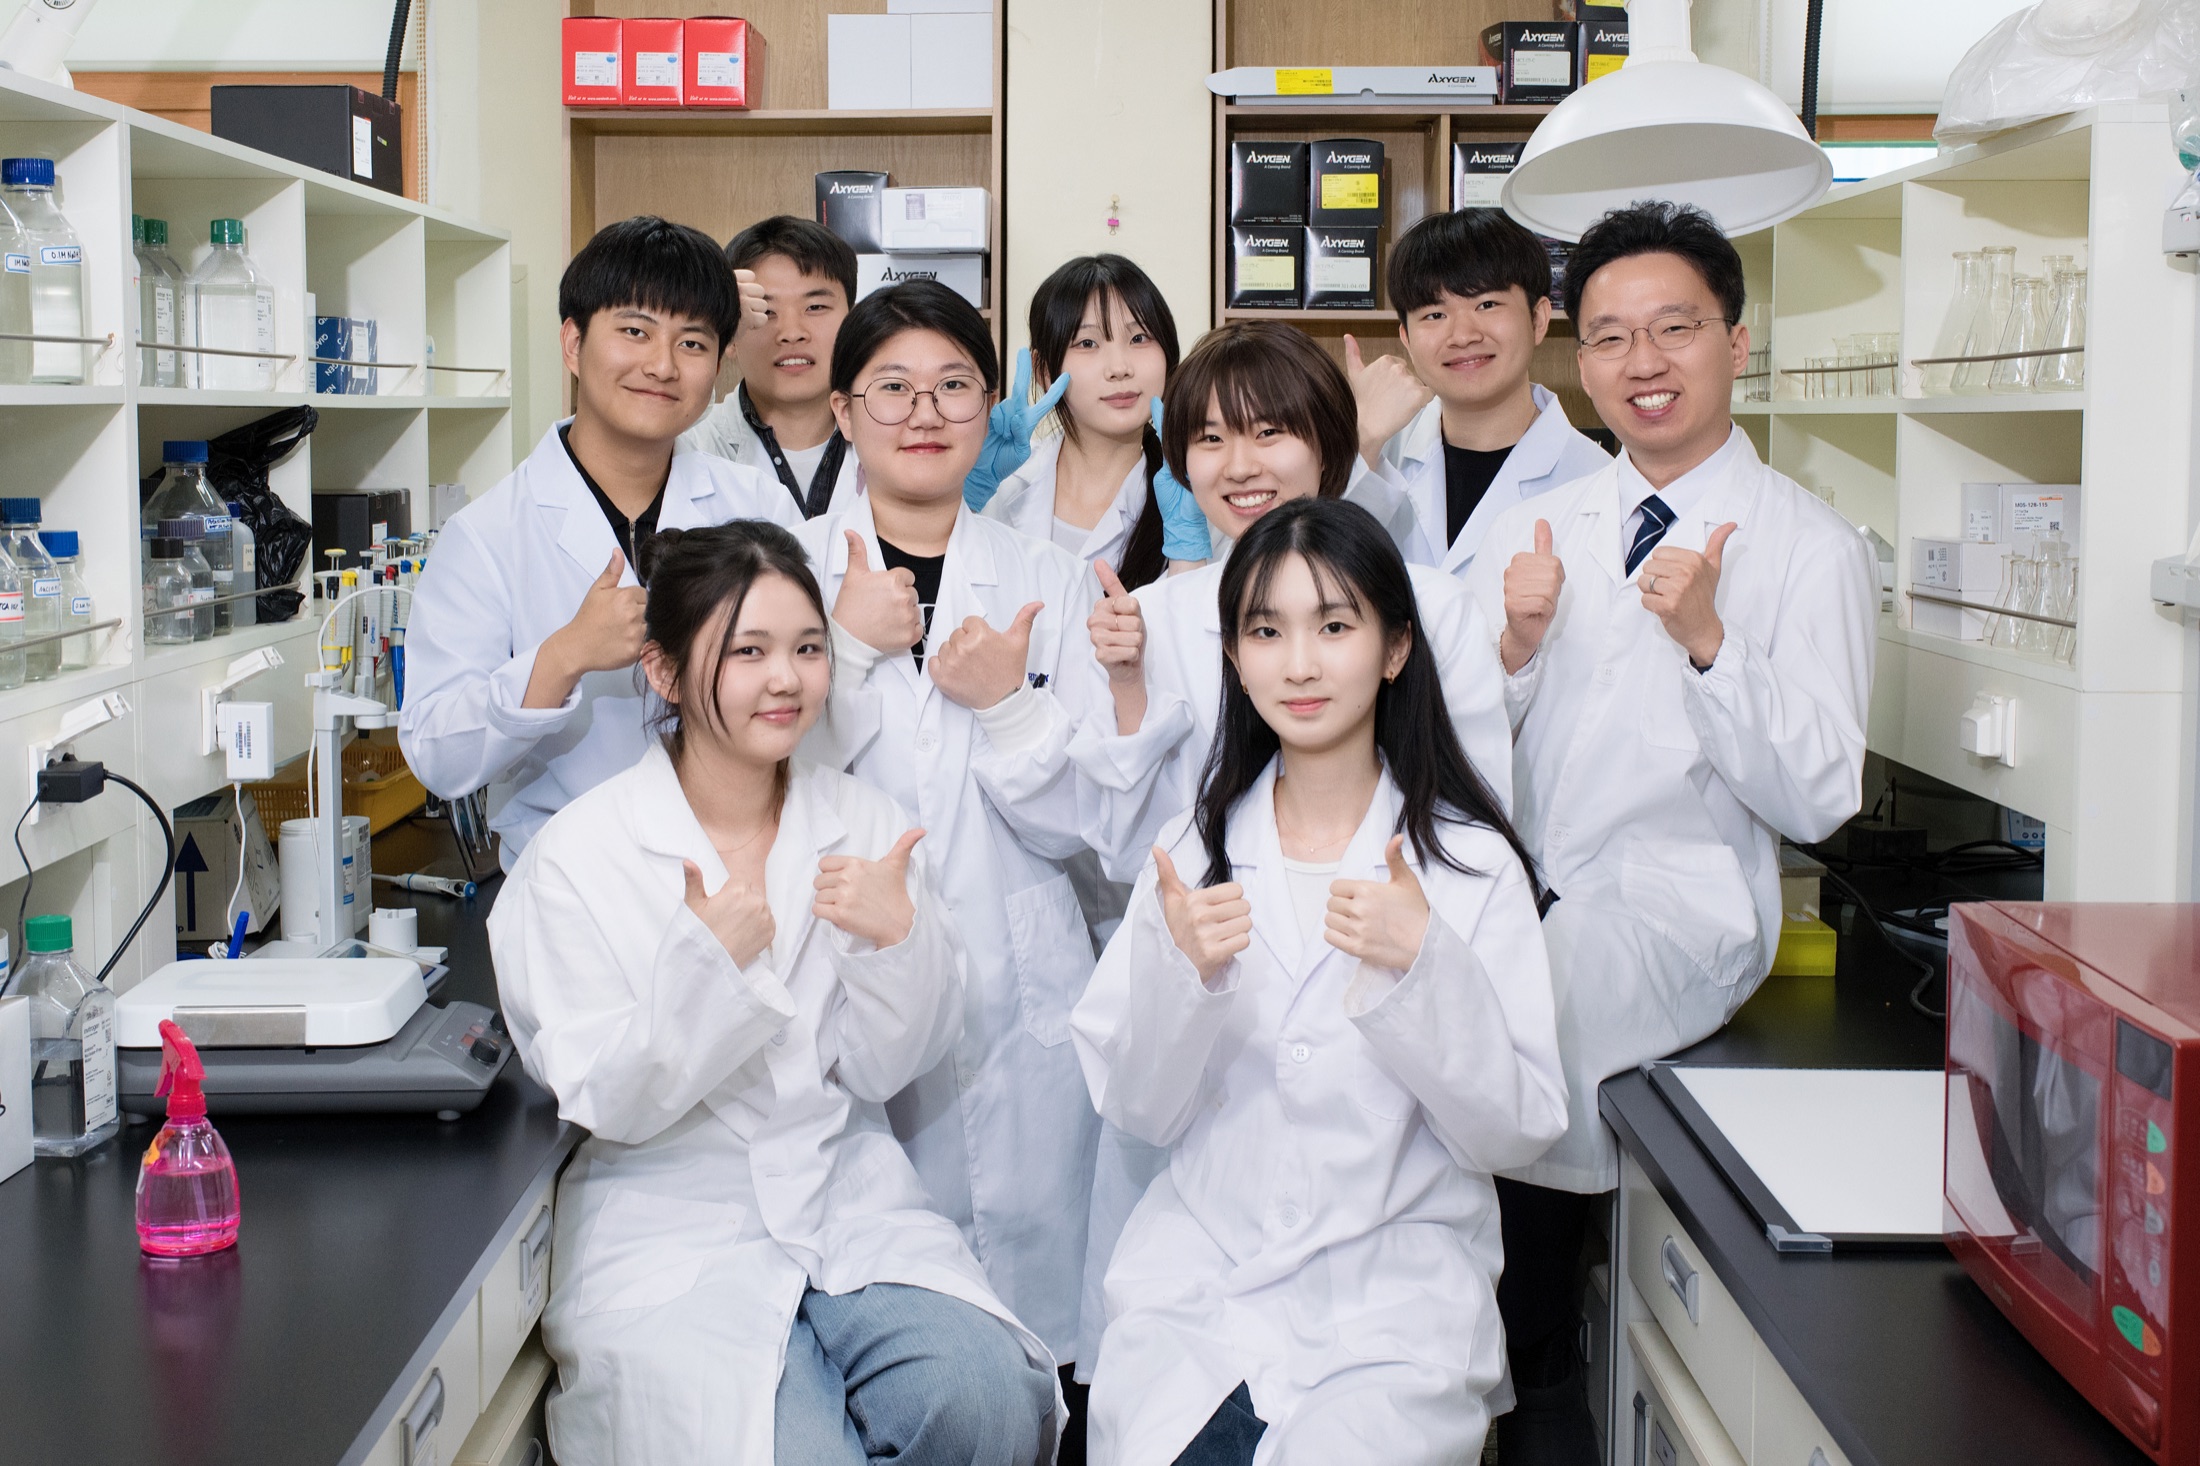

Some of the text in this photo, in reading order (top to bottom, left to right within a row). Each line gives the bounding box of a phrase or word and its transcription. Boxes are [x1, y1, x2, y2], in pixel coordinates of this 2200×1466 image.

[1520, 29, 1565, 42] AXYGEN
[1594, 29, 1629, 42] AXYGE
[1428, 73, 1475, 83] AXYGEN
[1246, 151, 1291, 164] AXYGEN
[1326, 151, 1371, 164] AXYGEN
[1470, 151, 1515, 164] AXYGEN
[830, 182, 874, 194] AXYGEN
[1244, 234, 1289, 247] AXYGEN
[1320, 235, 1365, 248] AXYGEN
[881, 267, 938, 281] AXYGEN
